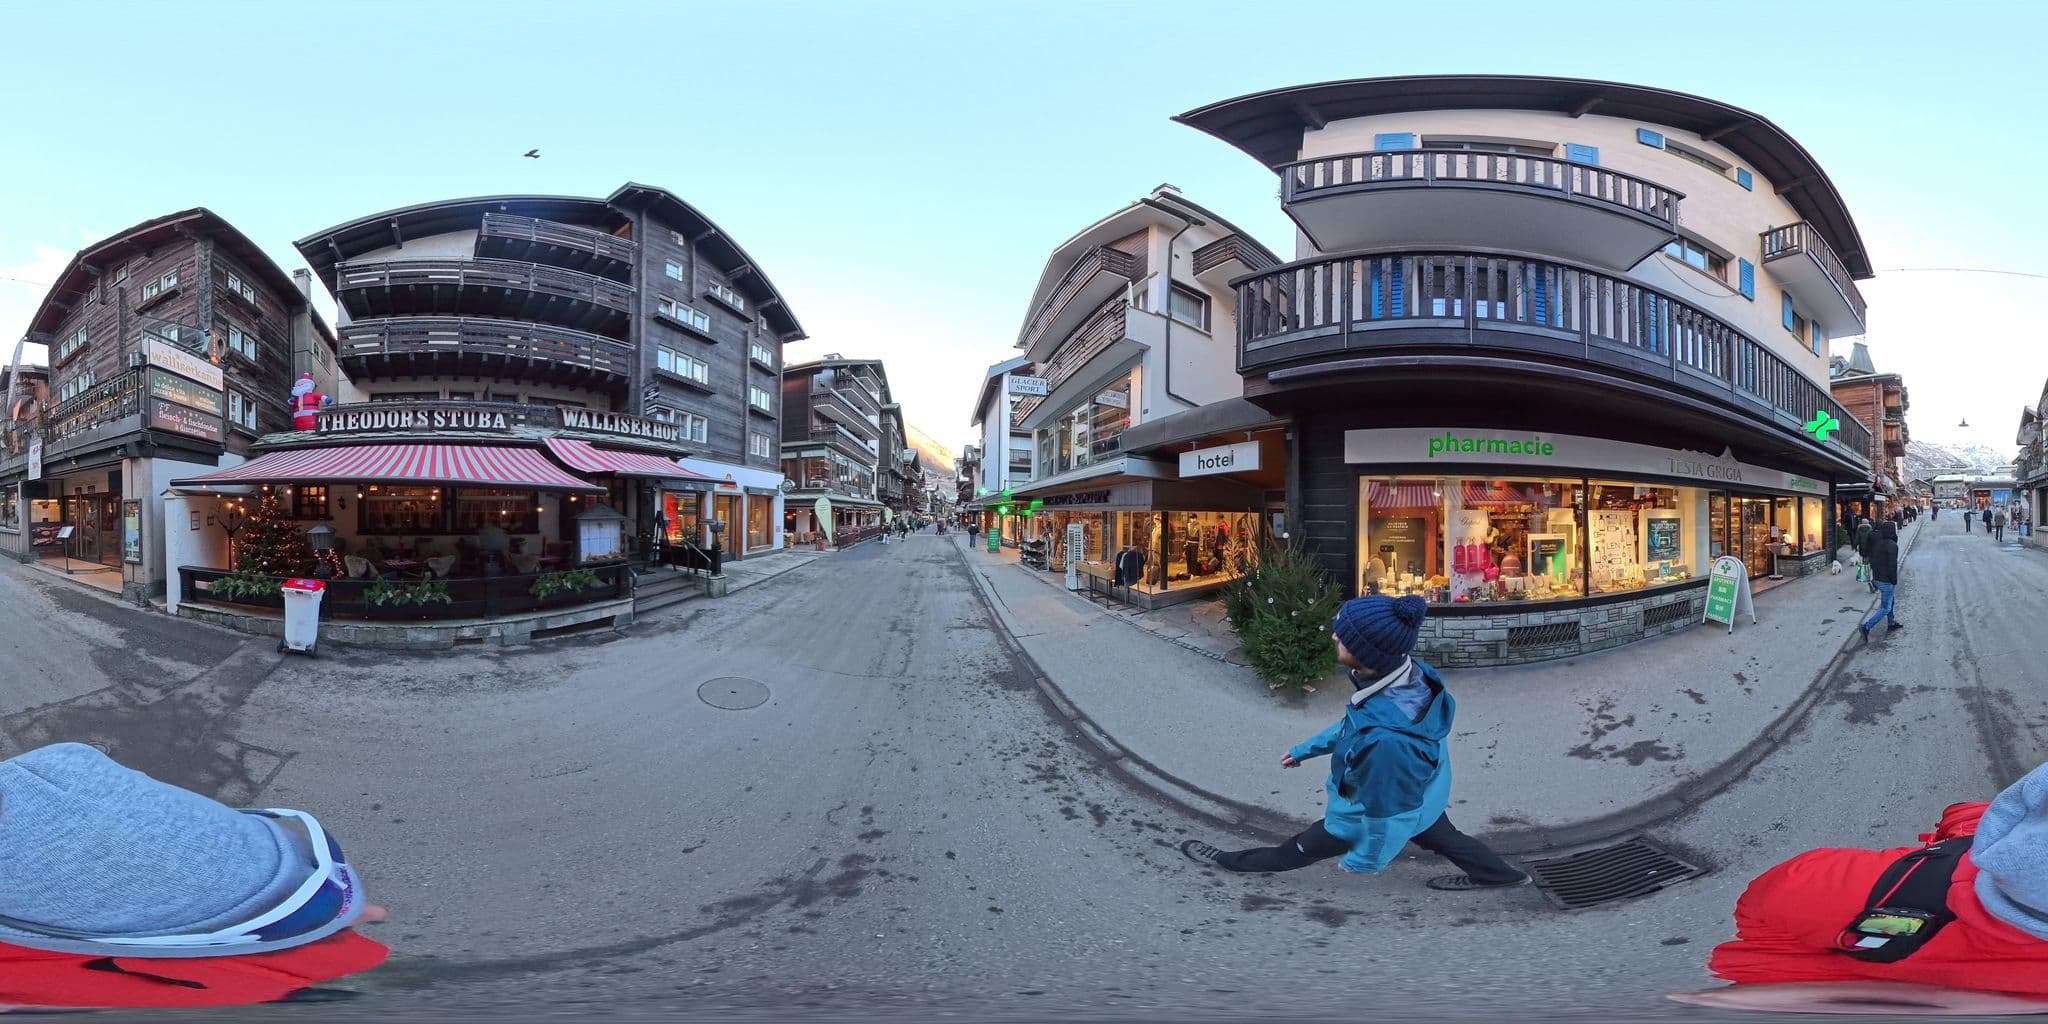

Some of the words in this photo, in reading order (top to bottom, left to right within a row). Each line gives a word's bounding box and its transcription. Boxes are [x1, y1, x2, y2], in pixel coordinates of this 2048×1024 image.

[1011, 378, 1045, 386] GLACIER
[1015, 385, 1040, 393] SPORT
[434, 411, 506, 429] STUBA
[561, 408, 680, 441] WALLISERHOF
[1428, 432, 1553, 458] pharmacie
[1197, 450, 1234, 470] hotel
[1667, 458, 1703, 476] TESTA
[1706, 464, 1742, 482] GRIGIA
